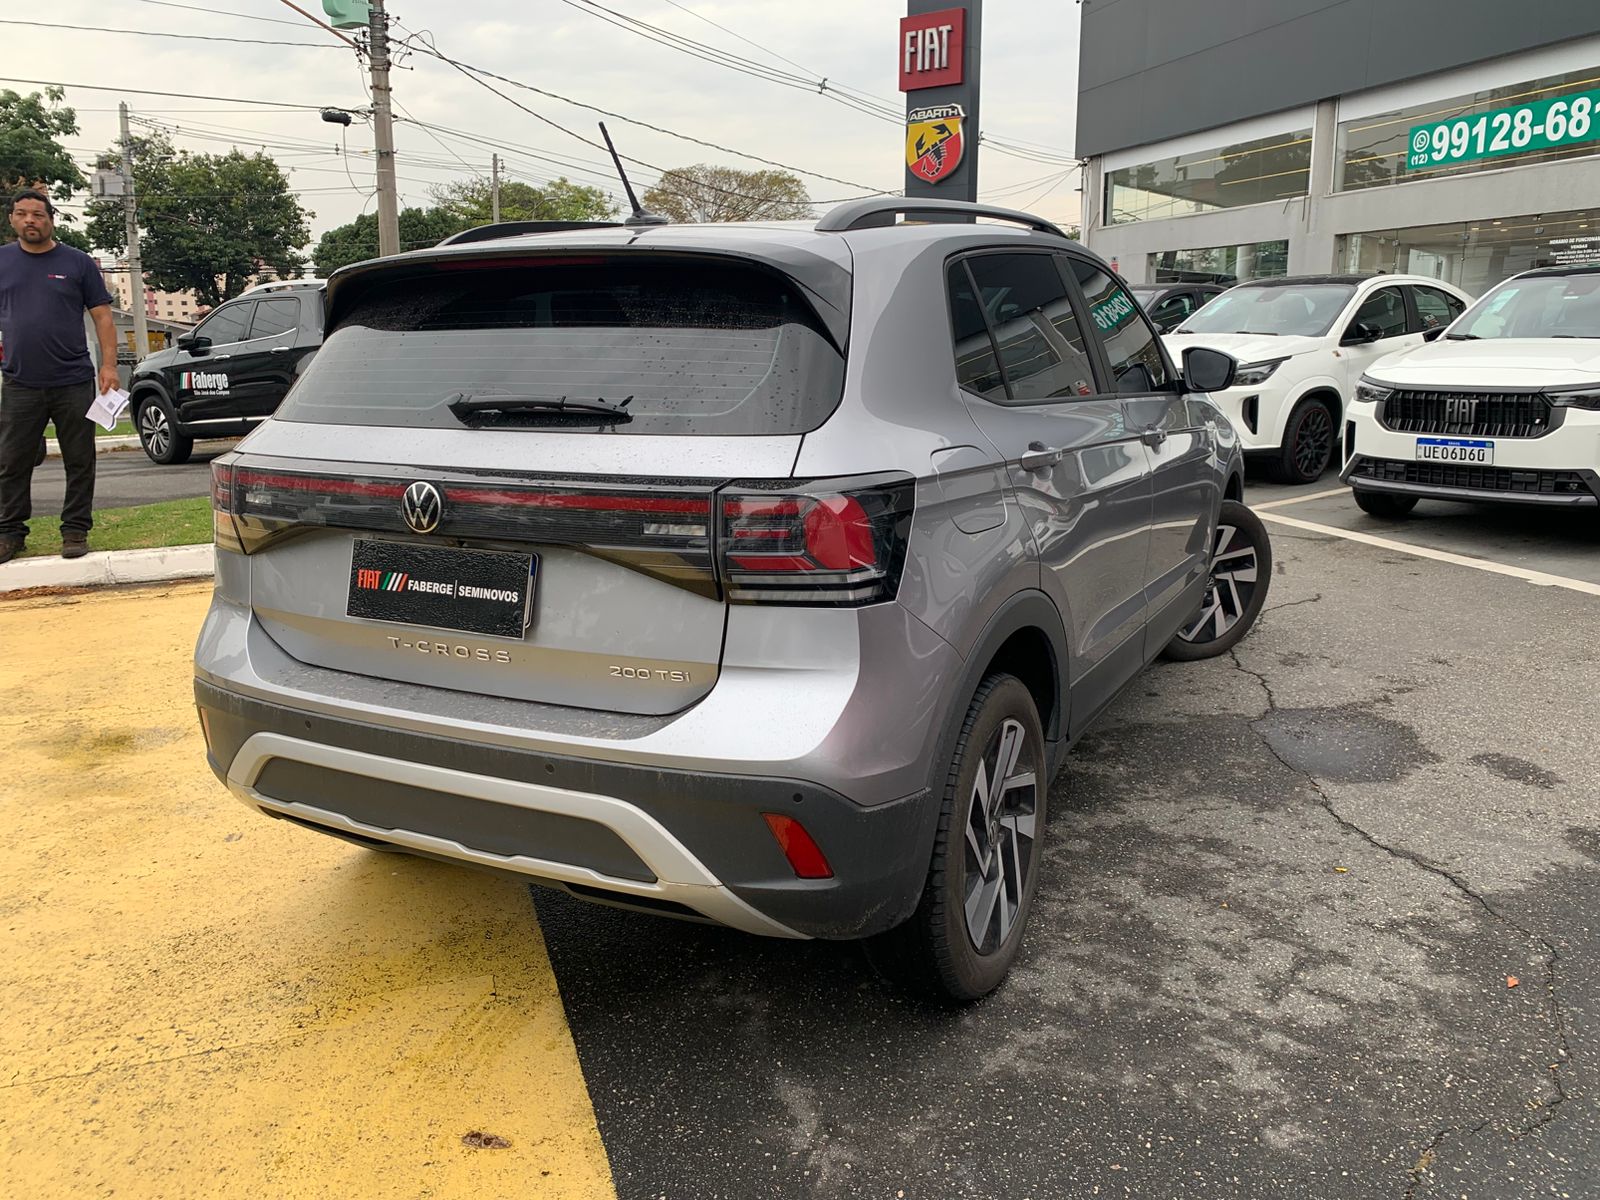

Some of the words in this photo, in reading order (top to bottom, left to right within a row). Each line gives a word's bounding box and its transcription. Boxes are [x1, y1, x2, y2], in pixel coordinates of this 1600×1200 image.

[905, 25, 952, 73] FIAT
[909, 109, 957, 121] ABARTH
[1411, 153, 1428, 166] (12)
[191, 371, 229, 390] Faberge
[1446, 398, 1479, 423] FIAT
[358, 569, 381, 590] FIAT
[408, 580, 453, 595] FABERGE
[458, 585, 518, 603] SEMINOVOS
[388, 637, 512, 663] T-CROSS
[609, 666, 651, 680] 200
